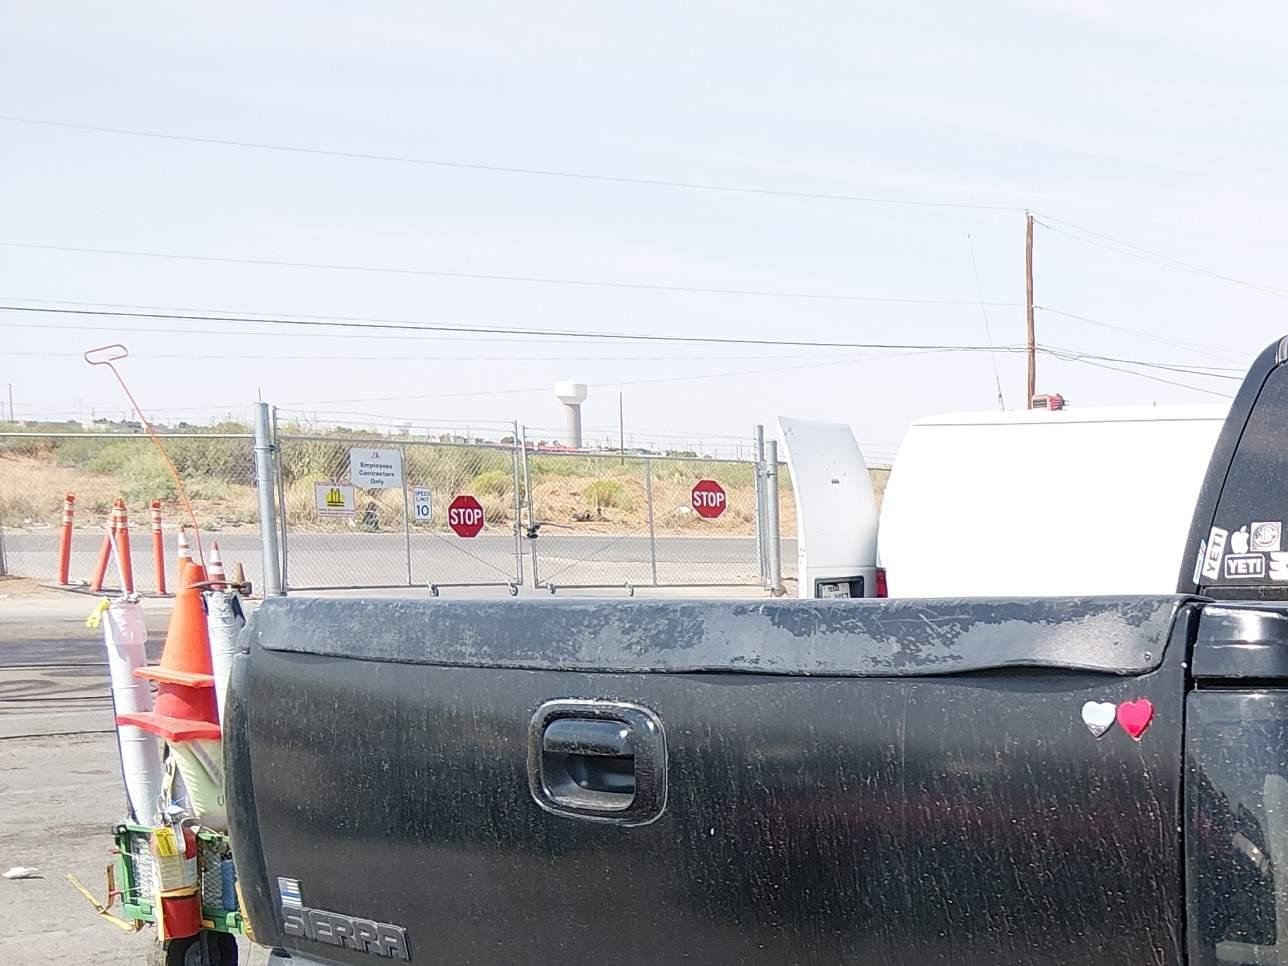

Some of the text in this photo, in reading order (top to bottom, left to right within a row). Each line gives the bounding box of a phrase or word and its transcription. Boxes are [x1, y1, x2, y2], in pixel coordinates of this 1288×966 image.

[360, 461, 393, 469] Employees
[358, 469, 395, 477] Contractors
[370, 478, 384, 486] Only
[693, 491, 725, 508] STOP
[416, 504, 430, 516] 10
[450, 508, 482, 525] STOP
[1207, 533, 1224, 573] YETI
[1227, 559, 1263, 574] YETI
[281, 904, 411, 961] SIERRA
